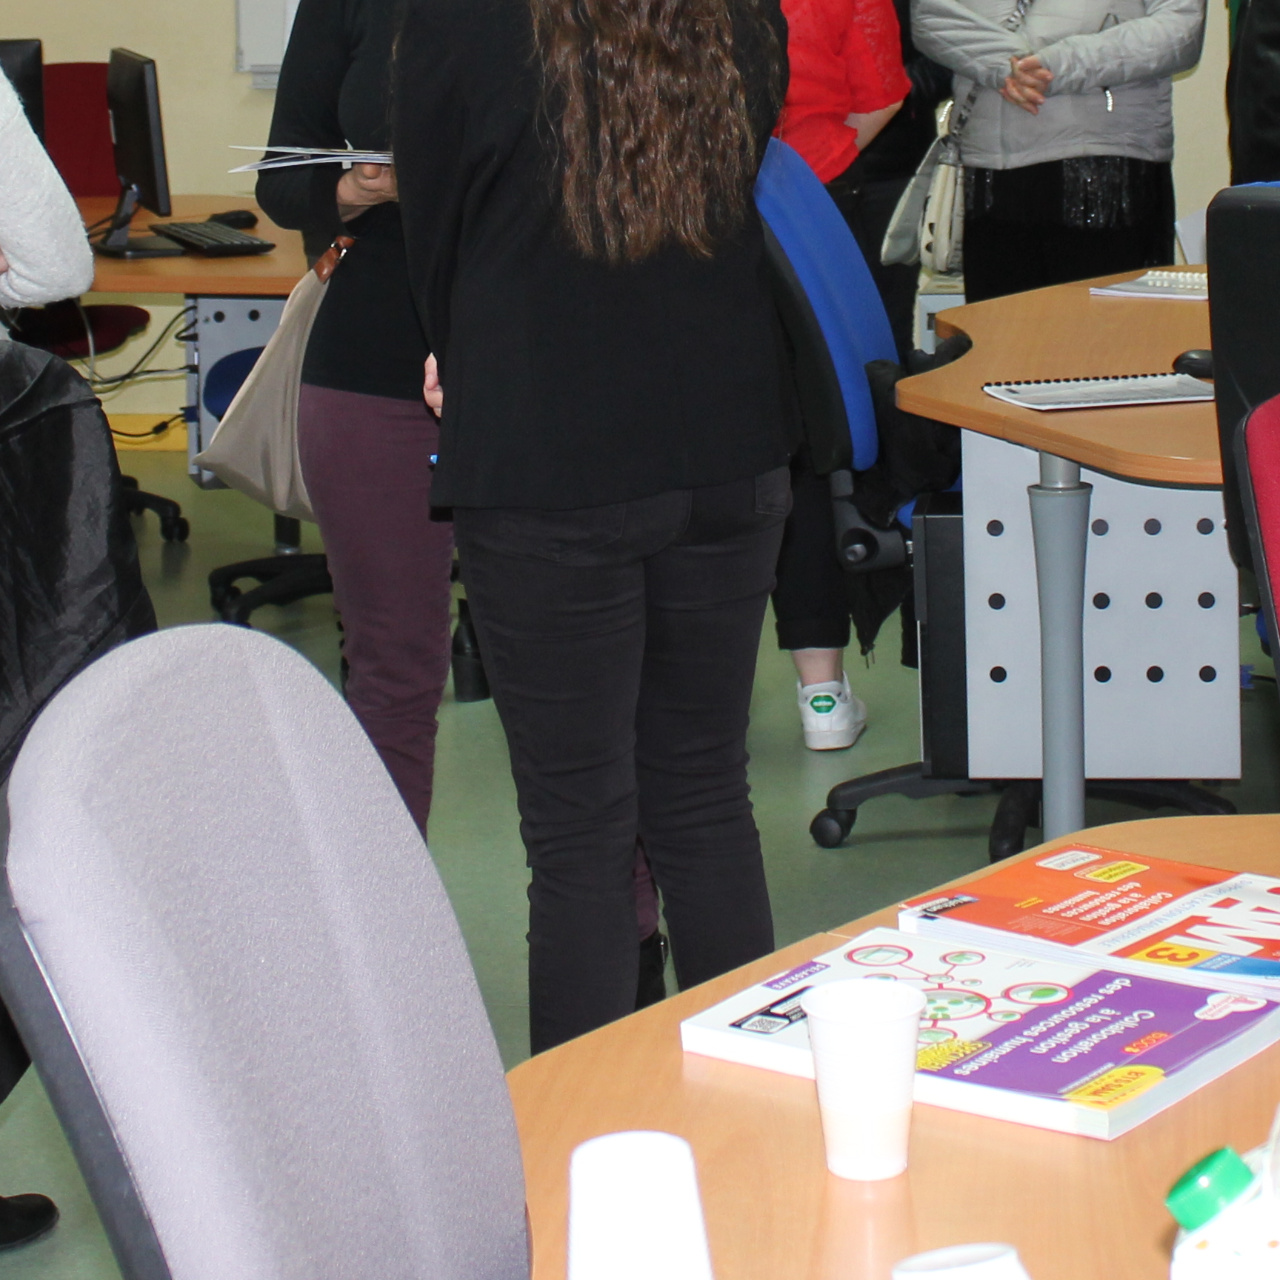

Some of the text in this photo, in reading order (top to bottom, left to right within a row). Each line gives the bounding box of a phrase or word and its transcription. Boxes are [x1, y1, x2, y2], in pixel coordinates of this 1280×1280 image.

[1041, 889, 1100, 915] humaines
[1060, 881, 1142, 918] des ressources
[1079, 901, 1122, 922] gestion
[1097, 891, 1174, 926] Collaboration
[1145, 946, 1200, 964] 3
[953, 977, 1132, 1077] des ressources humaines
[1029, 1007, 1122, 1054] à la gestion
[1051, 1009, 1156, 1063] Collaboration
[1091, 1076, 1126, 1097] SAM
[1124, 1070, 1147, 1085] BTS
